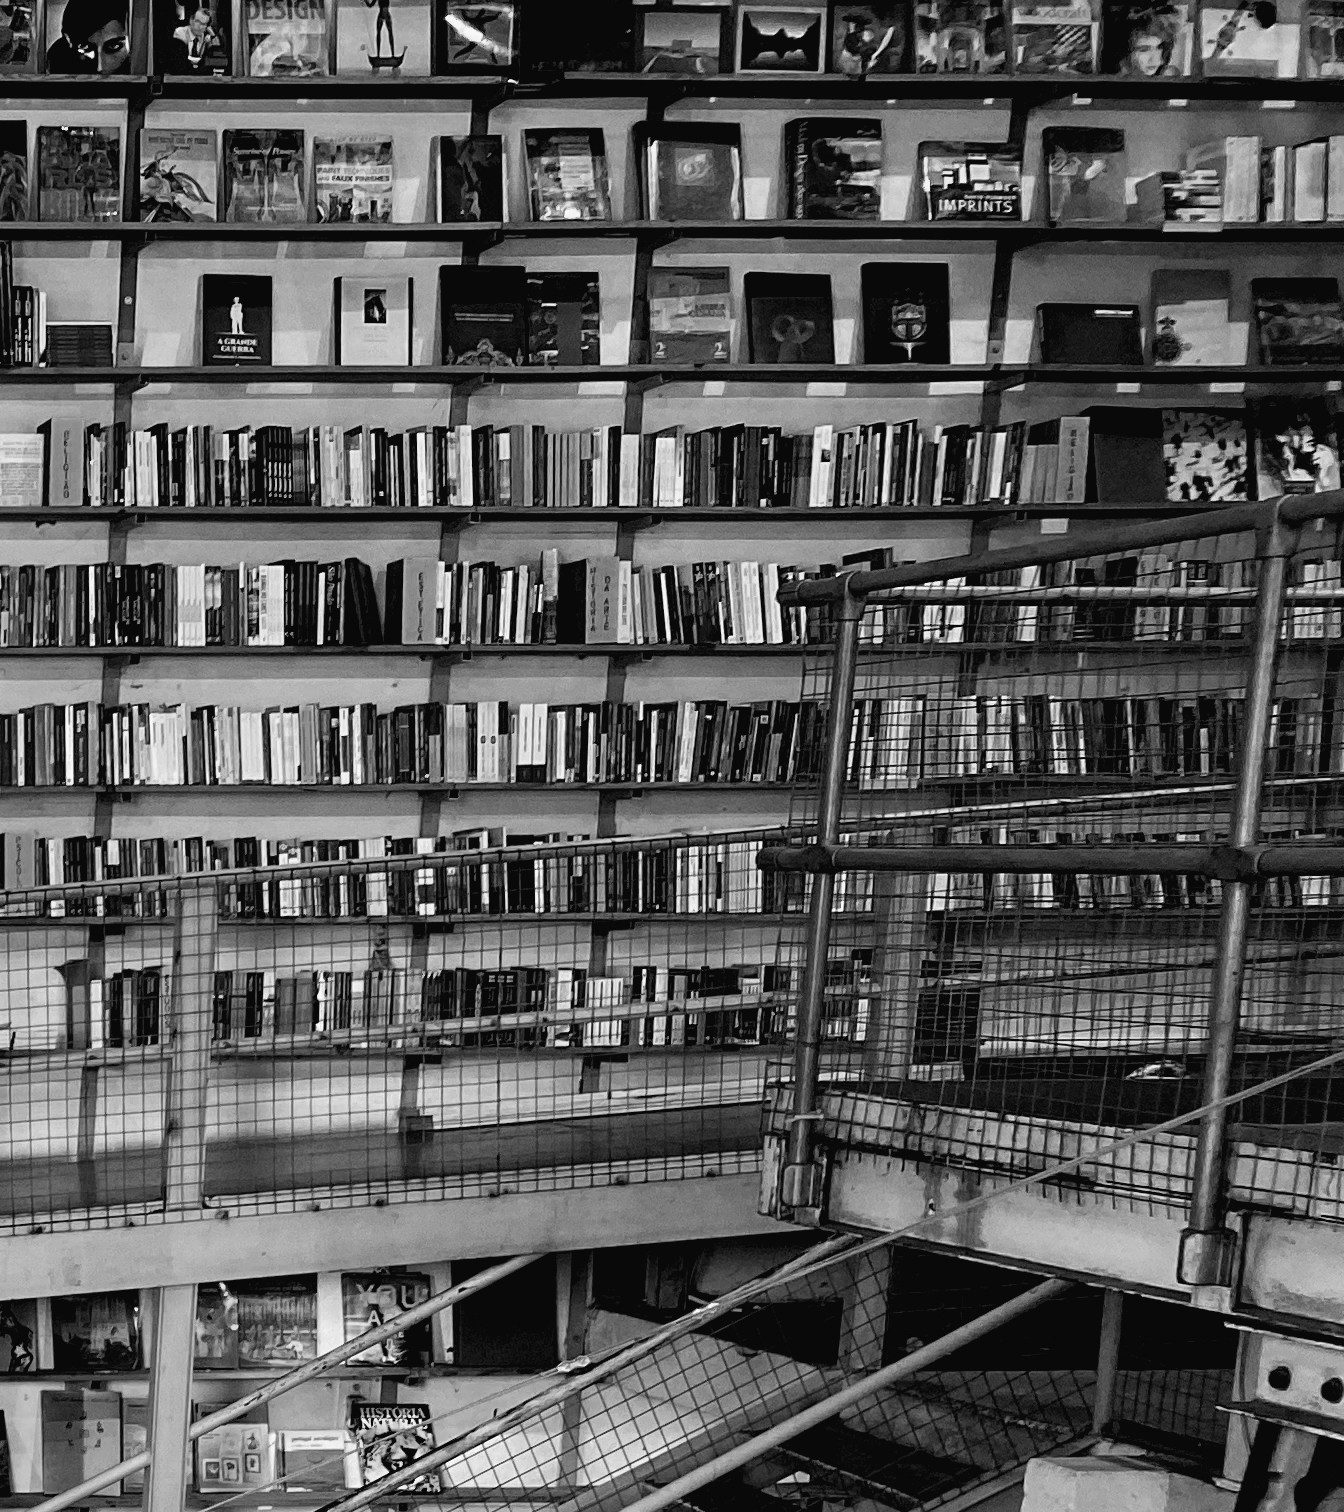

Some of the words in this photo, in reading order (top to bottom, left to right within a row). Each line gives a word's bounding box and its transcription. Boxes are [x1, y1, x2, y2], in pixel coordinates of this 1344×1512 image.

[330, 175, 353, 183] FAUX
[354, 175, 390, 183] FINISHES
[938, 198, 1013, 213] IMPRINTS
[224, 337, 258, 347] GRANDE
[220, 345, 255, 354] GUERRA
